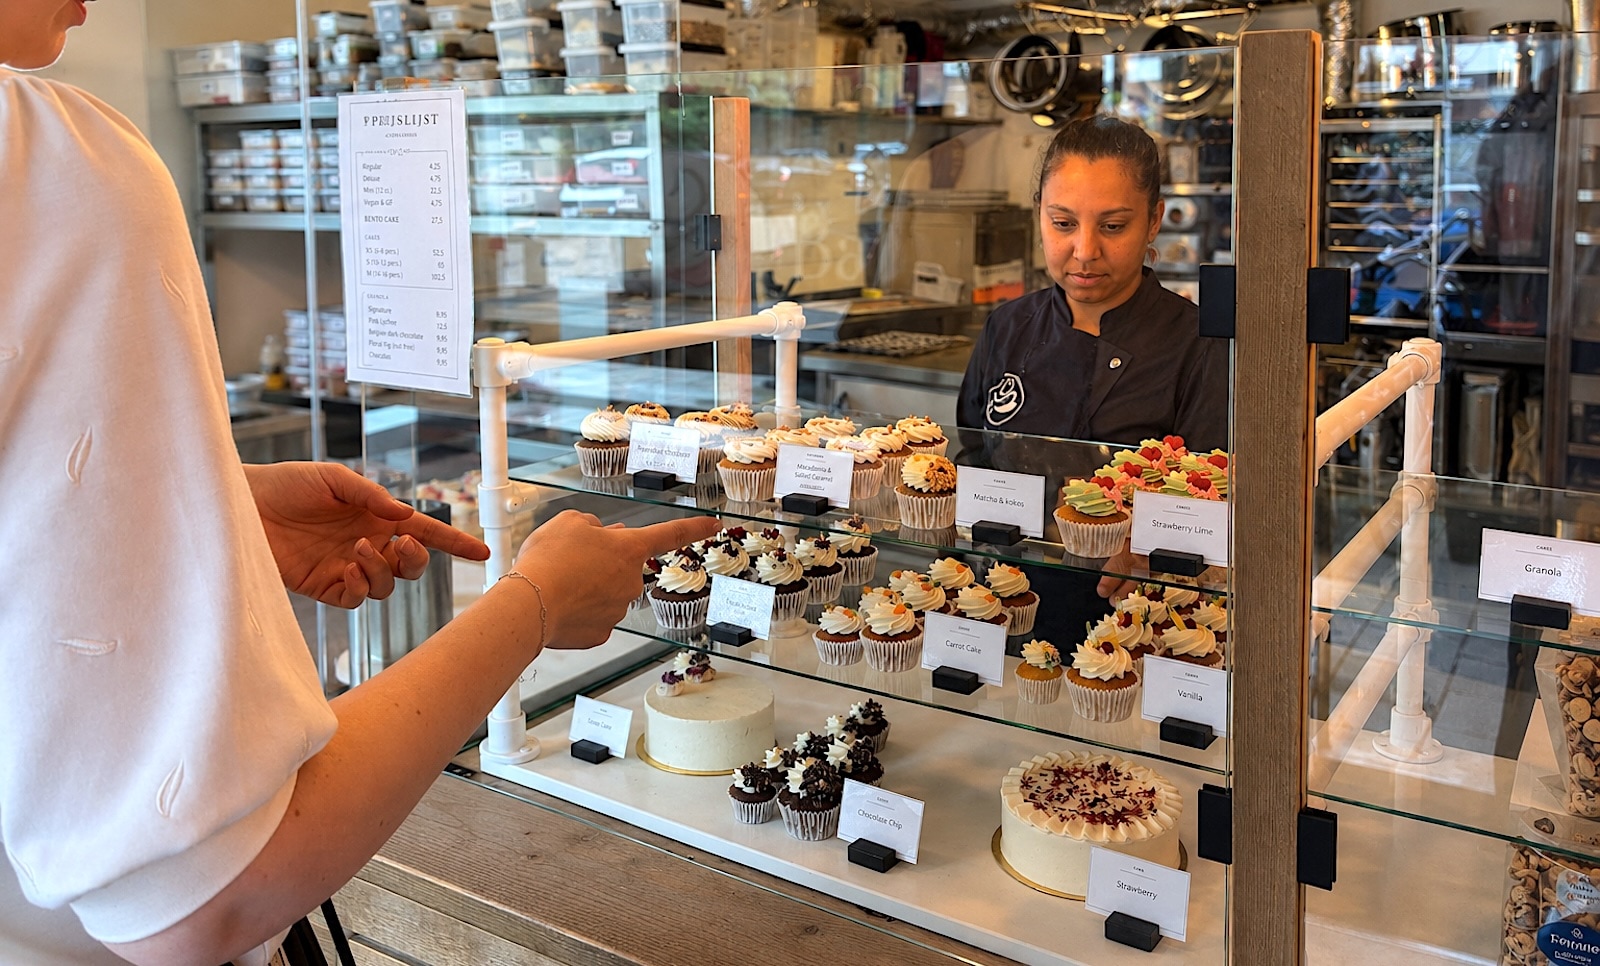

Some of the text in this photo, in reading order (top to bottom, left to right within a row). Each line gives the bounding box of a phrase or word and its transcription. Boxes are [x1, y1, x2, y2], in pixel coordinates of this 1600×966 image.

[364, 215, 384, 223] BENTO
[973, 493, 998, 504] Matcha
[1005, 498, 1025, 507] kokos
[1151, 519, 1214, 536] Strawberry Lime
[1524, 563, 1562, 577] Granola
[945, 639, 982, 655] Carrot Cake
[1177, 689, 1203, 702] Vanilla
[857, 808, 903, 831] Chocolate Chip
[1116, 879, 1158, 901] Strawberry
